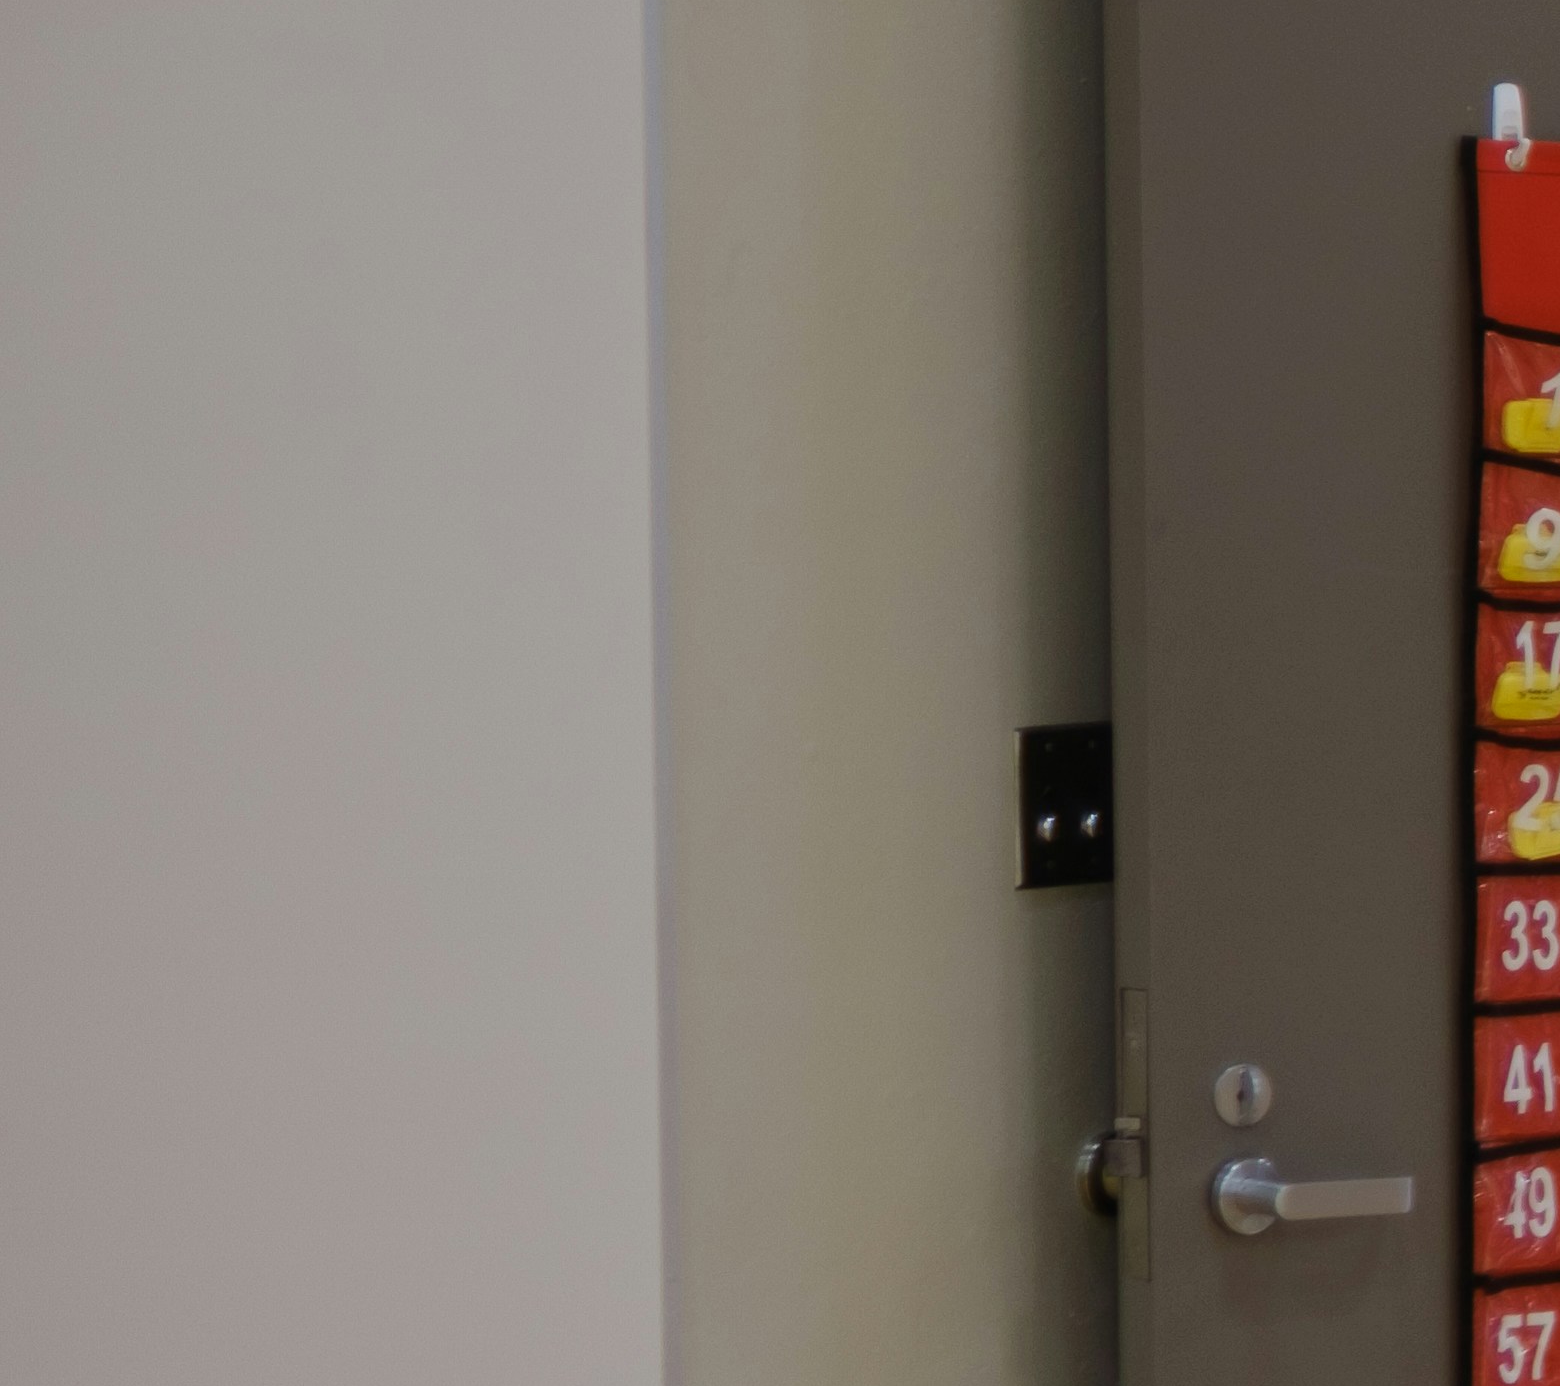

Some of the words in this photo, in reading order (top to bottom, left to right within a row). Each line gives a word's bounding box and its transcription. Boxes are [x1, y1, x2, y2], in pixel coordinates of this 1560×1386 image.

[1502, 900, 1560, 971] 33
[1504, 1043, 1556, 1113] 41
[1504, 1166, 1558, 1240] 49
[1497, 1312, 1556, 1384] 57
